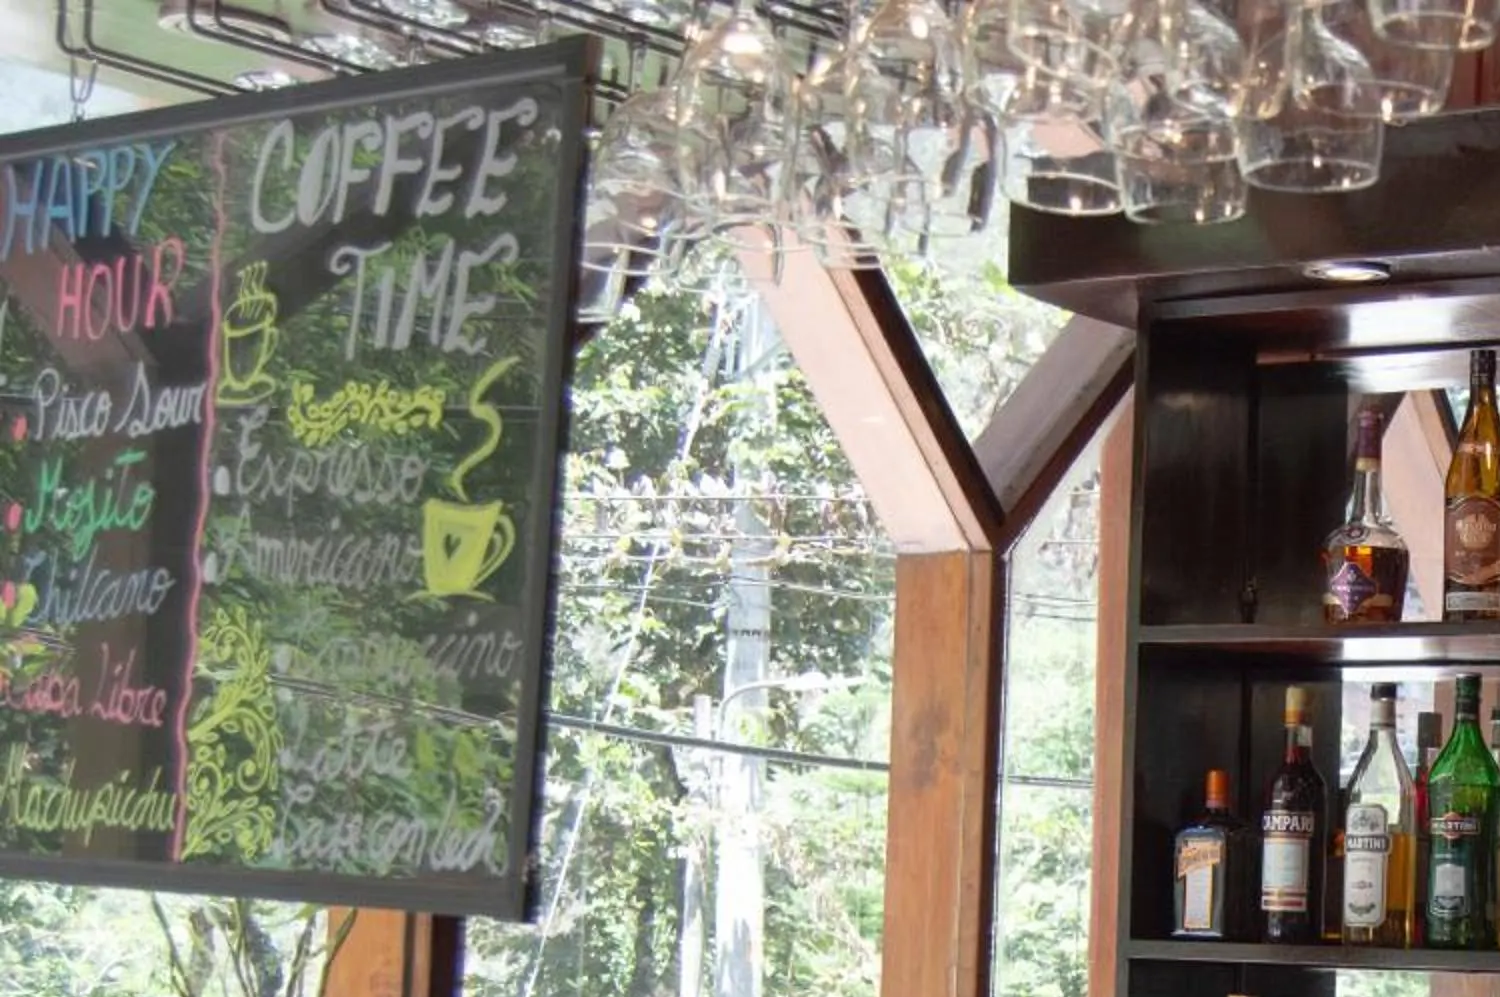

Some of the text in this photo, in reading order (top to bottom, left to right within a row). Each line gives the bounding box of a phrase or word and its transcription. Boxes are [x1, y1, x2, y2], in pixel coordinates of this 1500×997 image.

[0, 140, 178, 262] HAPPY
[251, 97, 539, 234] COFFEE
[57, 237, 186, 341] HOUR
[329, 233, 519, 361] TIME
[33, 361, 207, 441] Pisco Sour
[25, 451, 156, 562] Mojito
[236, 404, 429, 518] Expresso
